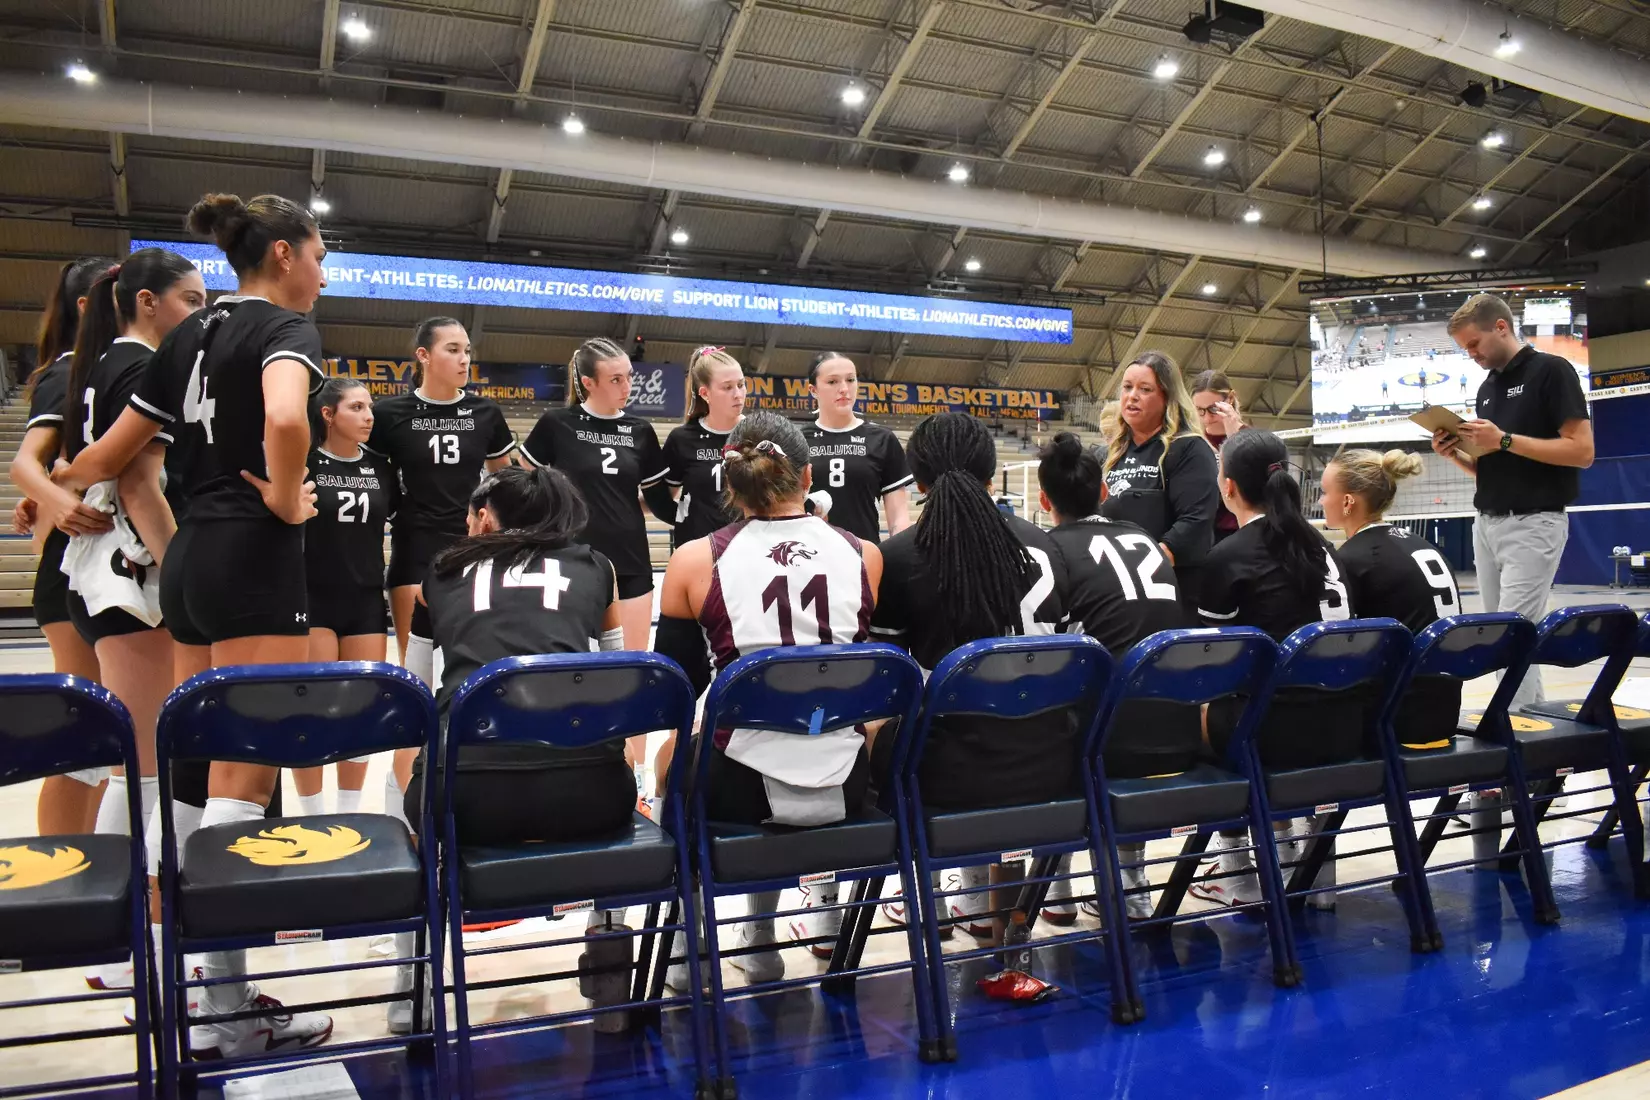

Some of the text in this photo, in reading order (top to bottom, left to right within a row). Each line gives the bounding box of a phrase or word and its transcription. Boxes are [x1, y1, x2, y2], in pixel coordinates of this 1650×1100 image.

[191, 259, 1069, 332] ORT ENT-ATHLETES: LIONATHLETICS.COM/GIVE SUPPORT LION STUDENT-ATHLETES: LIONATHLETICS.COM/GIVE
[366, 381, 409, 396] AMENTS
[480, 385, 535, 400] MERICANS
[645, 369, 663, 393] &
[744, 376, 1060, 409] ON WEN'S BASKETBALL
[1506, 383, 1525, 398] SIU
[183, 349, 216, 445] 4
[759, 398, 783, 409] NCAA
[786, 398, 809, 410] ELITE
[866, 402, 890, 414] NCAA
[891, 403, 951, 416] TOURNAMENTS
[411, 417, 475, 431] SALUKIS
[428, 434, 461, 465] 13
[575, 430, 635, 448] SALUKIS
[809, 444, 867, 457] SALUKIS
[600, 447, 619, 475] 2
[696, 448, 722, 461] SAL
[315, 473, 381, 490] SALUKIS
[828, 458, 845, 488] 8
[337, 490, 370, 524] 21
[1089, 533, 1177, 601] 12
[462, 556, 572, 613] 14
[1012, 545, 1058, 636] 2
[1411, 548, 1463, 620] 9
[761, 573, 834, 647] 11
[1019, 951, 1030, 964] G
